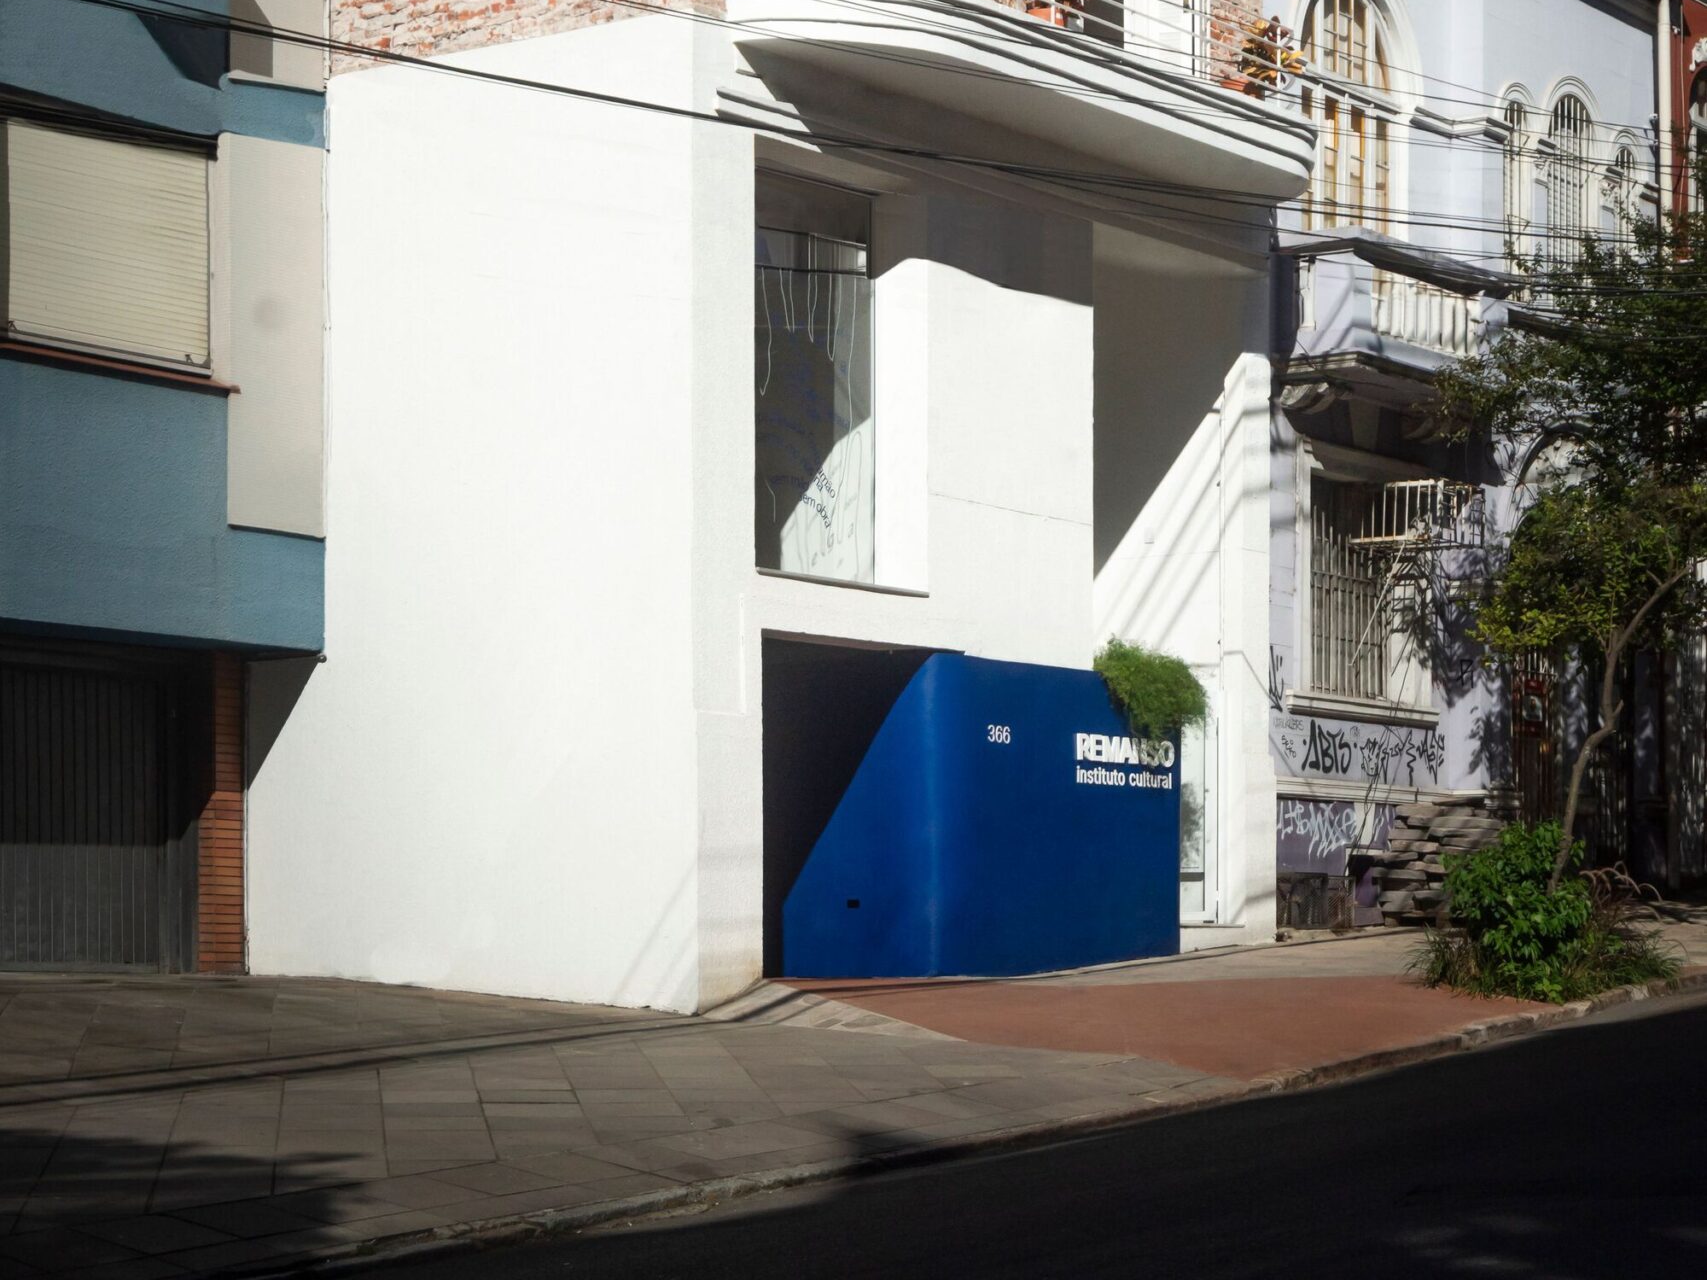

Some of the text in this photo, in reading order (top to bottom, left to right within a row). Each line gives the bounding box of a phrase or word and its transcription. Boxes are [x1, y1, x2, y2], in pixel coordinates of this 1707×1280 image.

[987, 724, 1011, 744] 366
[1076, 732, 1175, 768] REMANSO
[1076, 765, 1172, 789] instituto cultural
